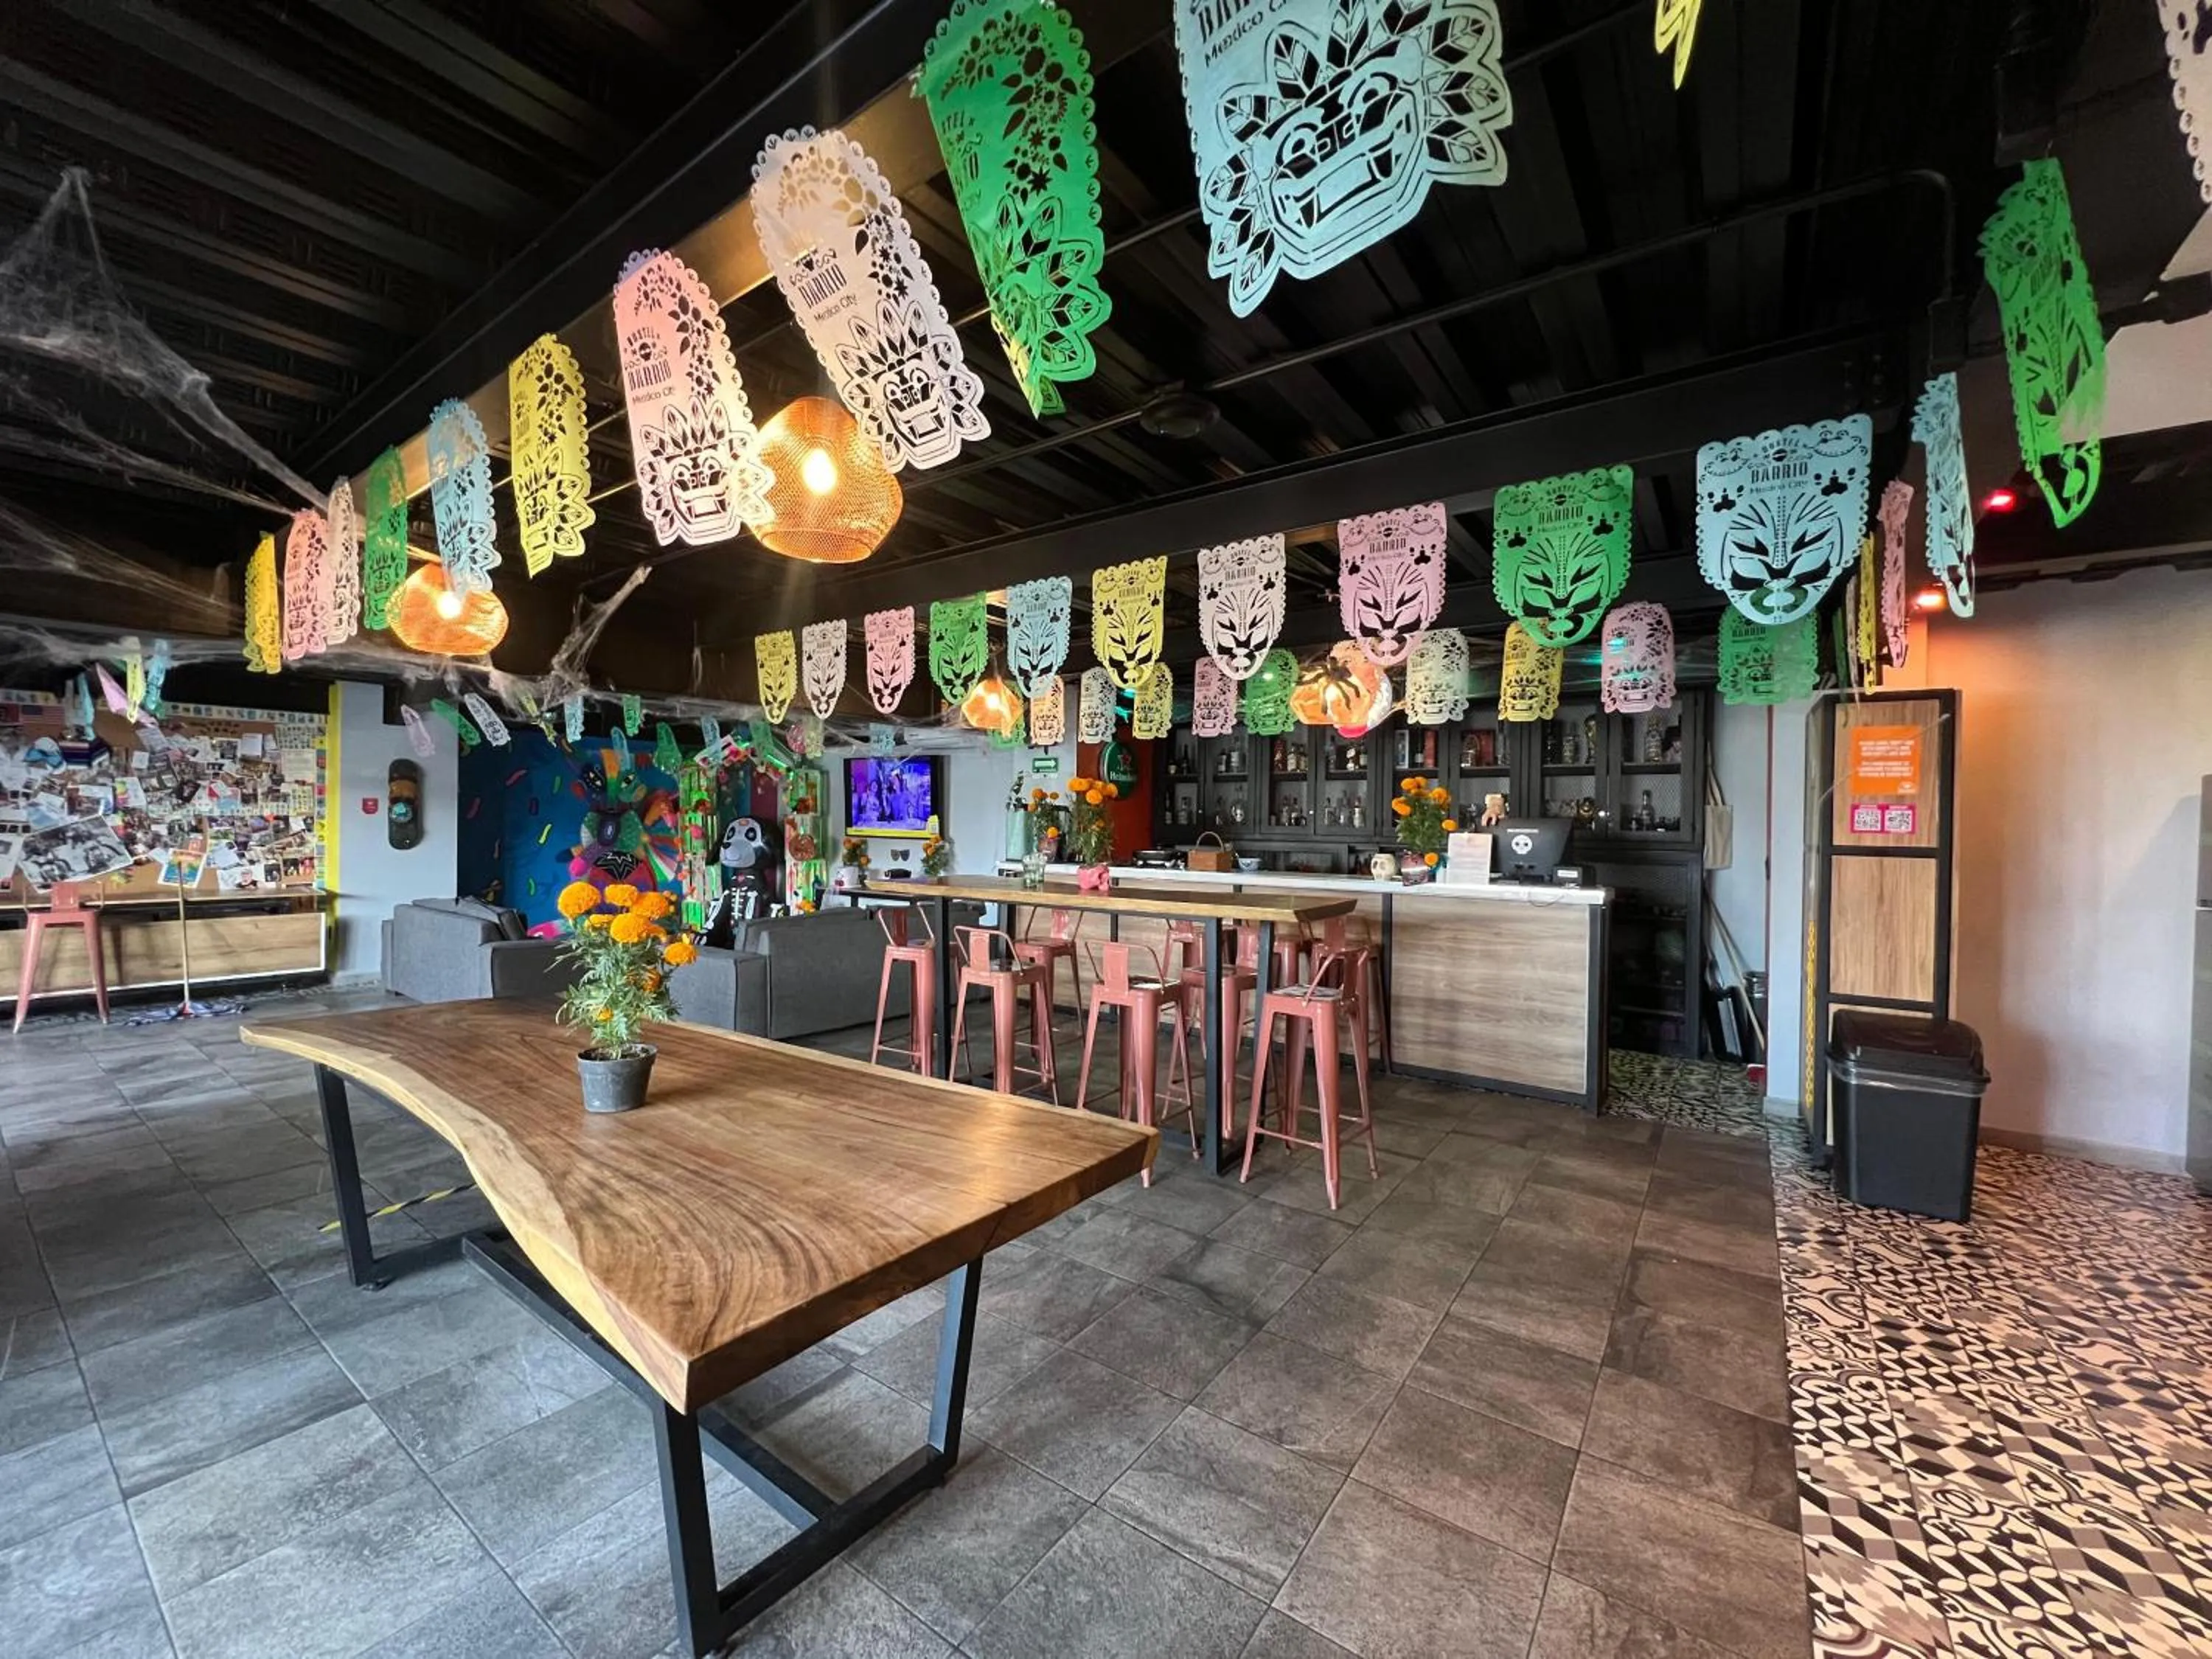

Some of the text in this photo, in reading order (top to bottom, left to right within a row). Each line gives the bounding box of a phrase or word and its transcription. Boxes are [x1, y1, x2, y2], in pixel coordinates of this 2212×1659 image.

[798, 262, 847, 310] BARRIO
[628, 358, 672, 392] BARRIO
[1751, 462, 1809, 484] BARRIO
[1538, 505, 1584, 525] BARRIO
[1369, 538, 1407, 554] BARRIO
[1225, 566, 1256, 582] BARRIO
